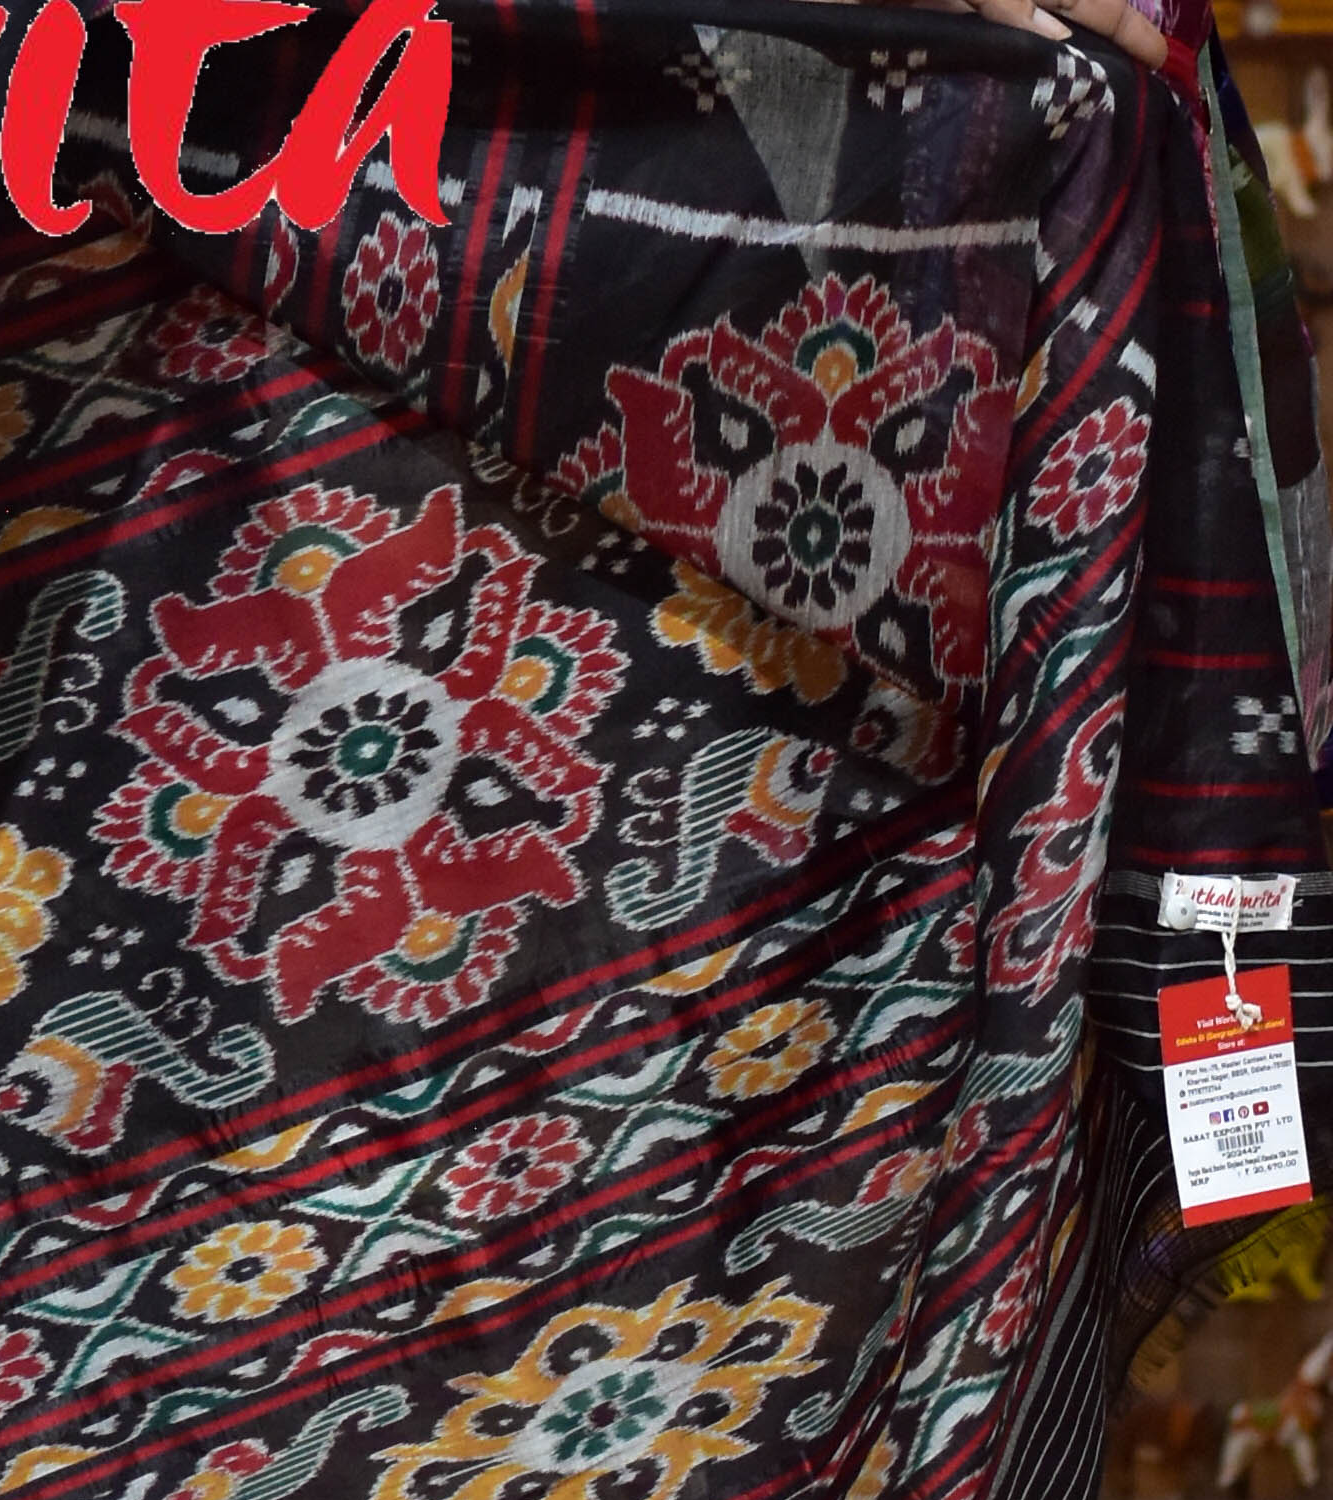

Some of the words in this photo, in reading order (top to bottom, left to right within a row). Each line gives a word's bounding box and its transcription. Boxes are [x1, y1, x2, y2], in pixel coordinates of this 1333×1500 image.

[1213, 1123, 1253, 1138] EXPORTS
[1254, 1119, 1270, 1130] PVT
[1276, 1115, 1293, 1126] LTD
